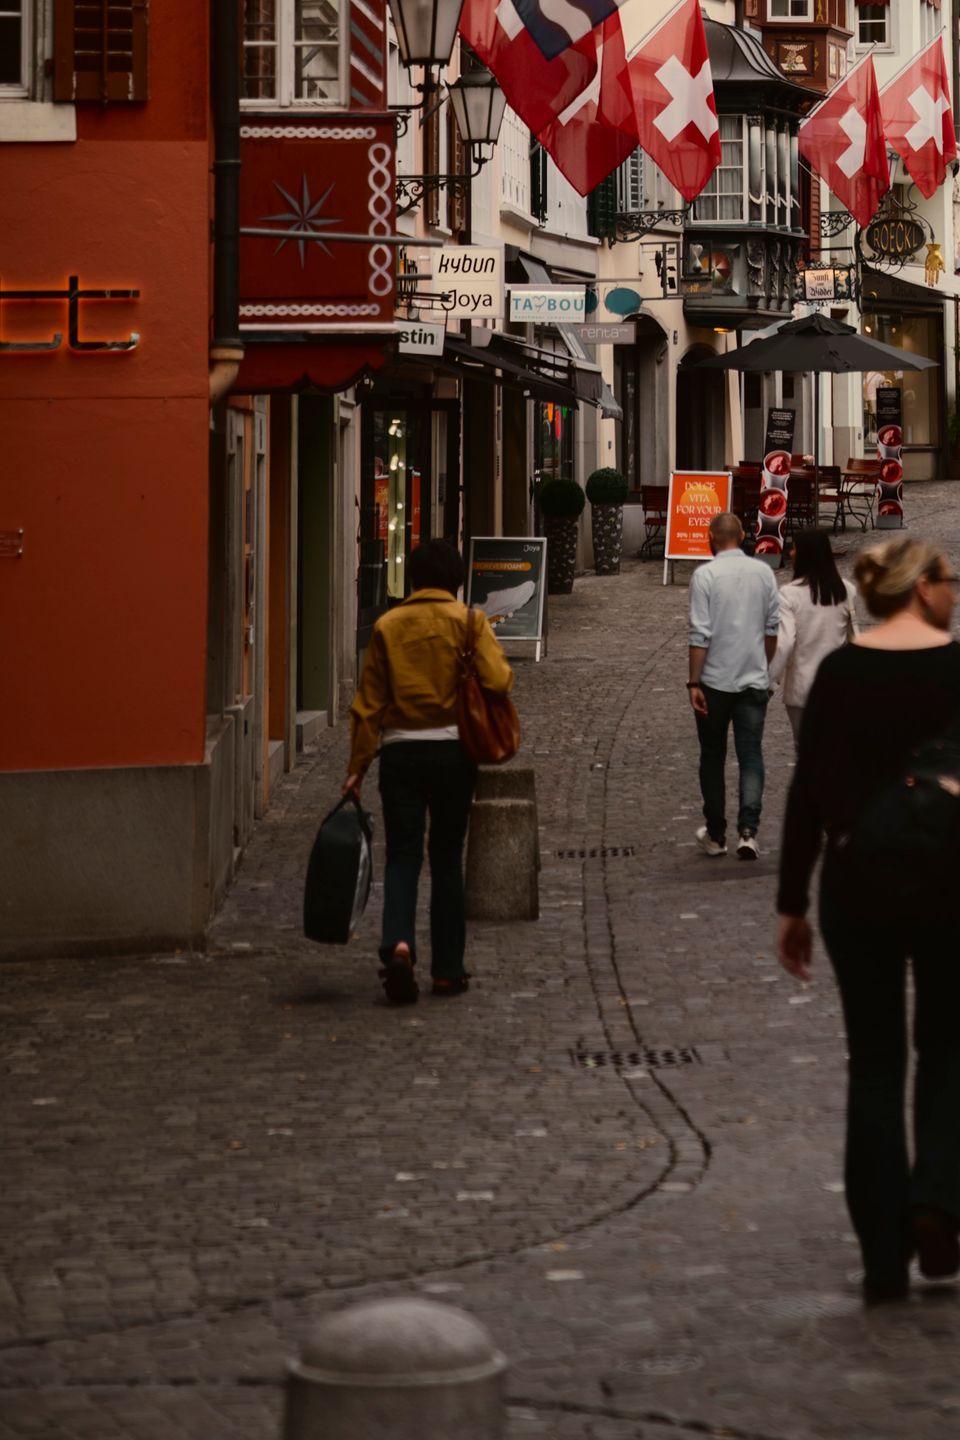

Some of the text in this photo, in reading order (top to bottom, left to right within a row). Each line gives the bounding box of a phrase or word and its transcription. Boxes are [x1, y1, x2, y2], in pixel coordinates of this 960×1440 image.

[873, 222, 919, 253] ROECKL
[438, 254, 496, 273] kybun
[441, 289, 493, 312] Joya
[685, 481, 716, 491] DOLCE
[689, 494, 710, 503] VITA
[676, 505, 722, 515] FOR YOUR
[688, 517, 711, 527] EYES
